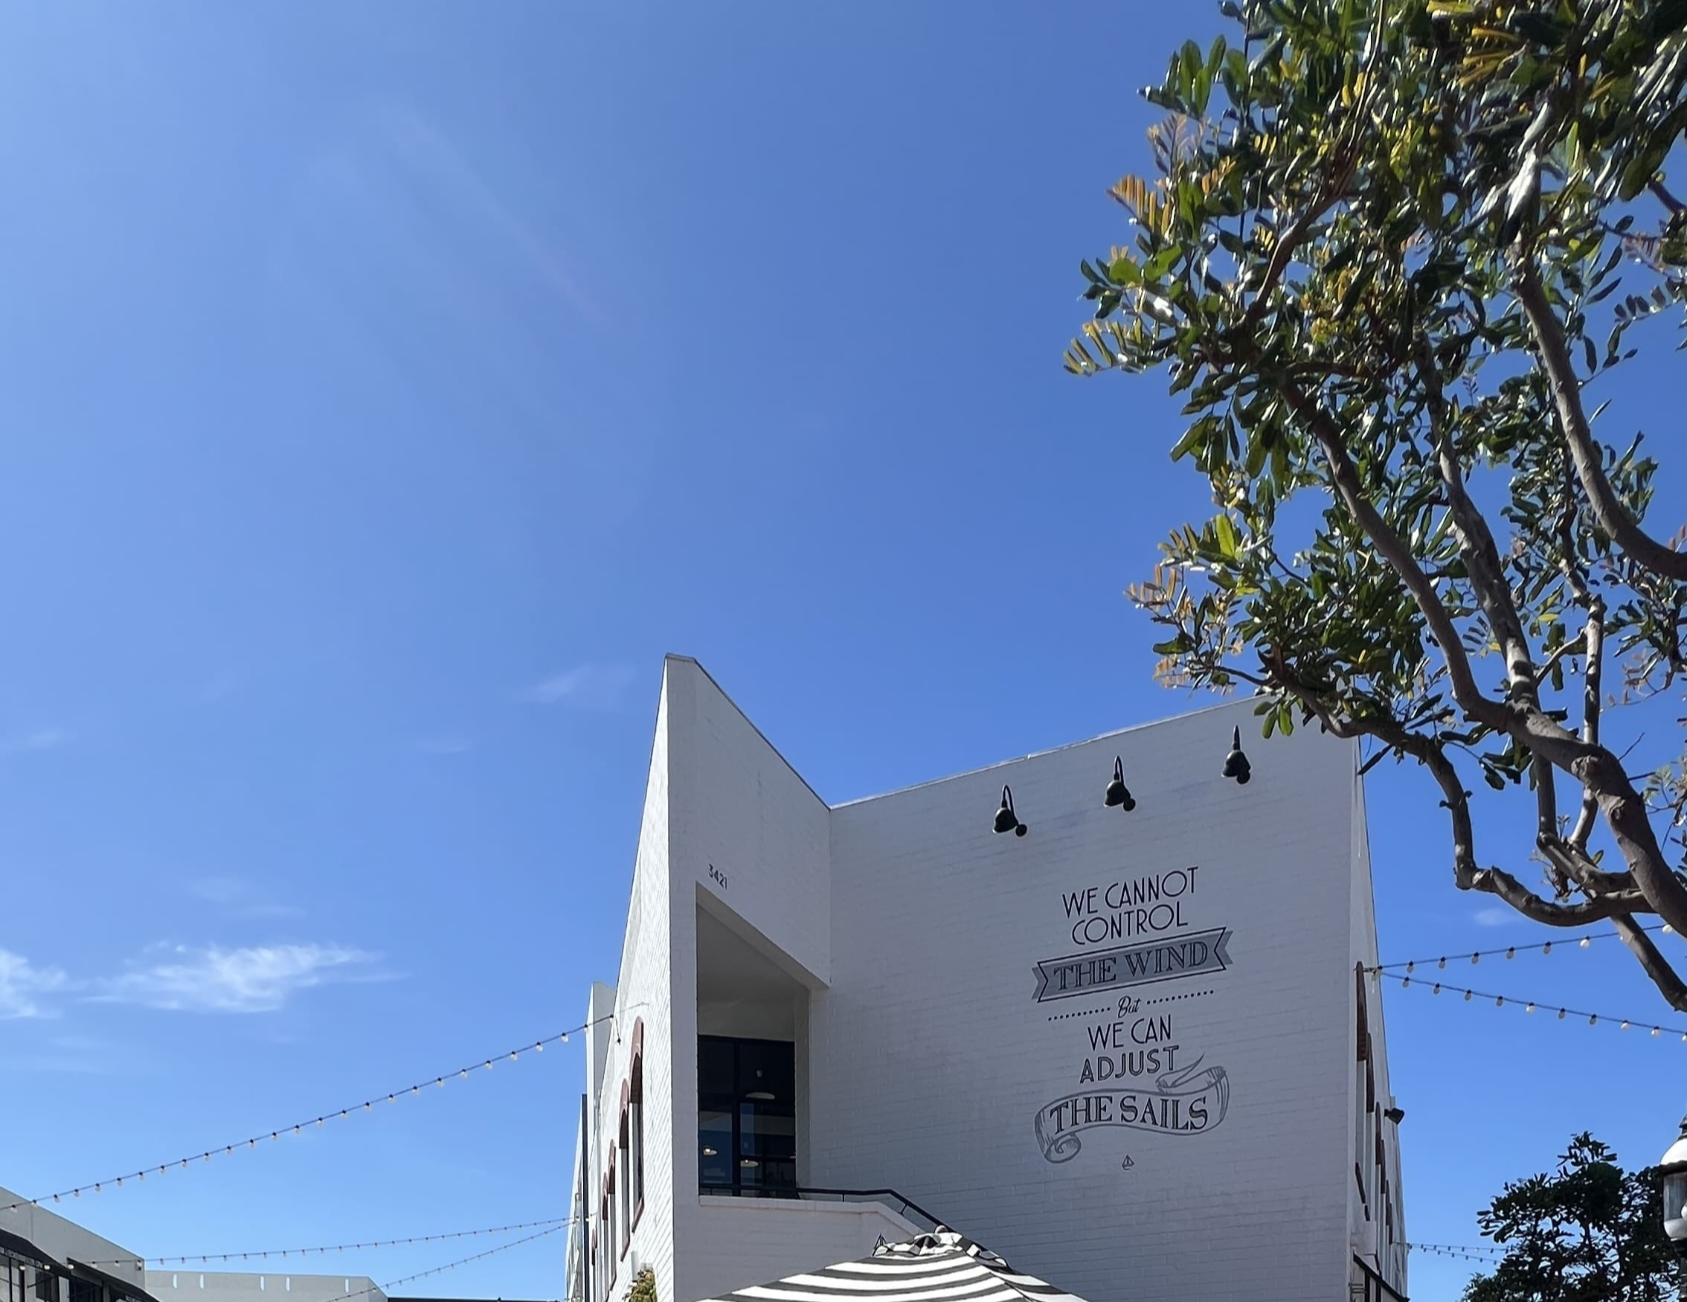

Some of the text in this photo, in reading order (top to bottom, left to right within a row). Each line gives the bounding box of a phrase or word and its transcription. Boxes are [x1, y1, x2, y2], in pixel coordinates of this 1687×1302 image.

[708, 863, 728, 890] 3421
[1062, 866, 1199, 918] WE CANNOT
[1072, 901, 1188, 945] CONTROL
[1053, 940, 1208, 991] THE WIND
[1117, 995, 1141, 1018] But
[1088, 1014, 1172, 1051] WE CAN
[1079, 1045, 1180, 1084] ADJUST
[1050, 1095, 1209, 1135] THE SAILS
